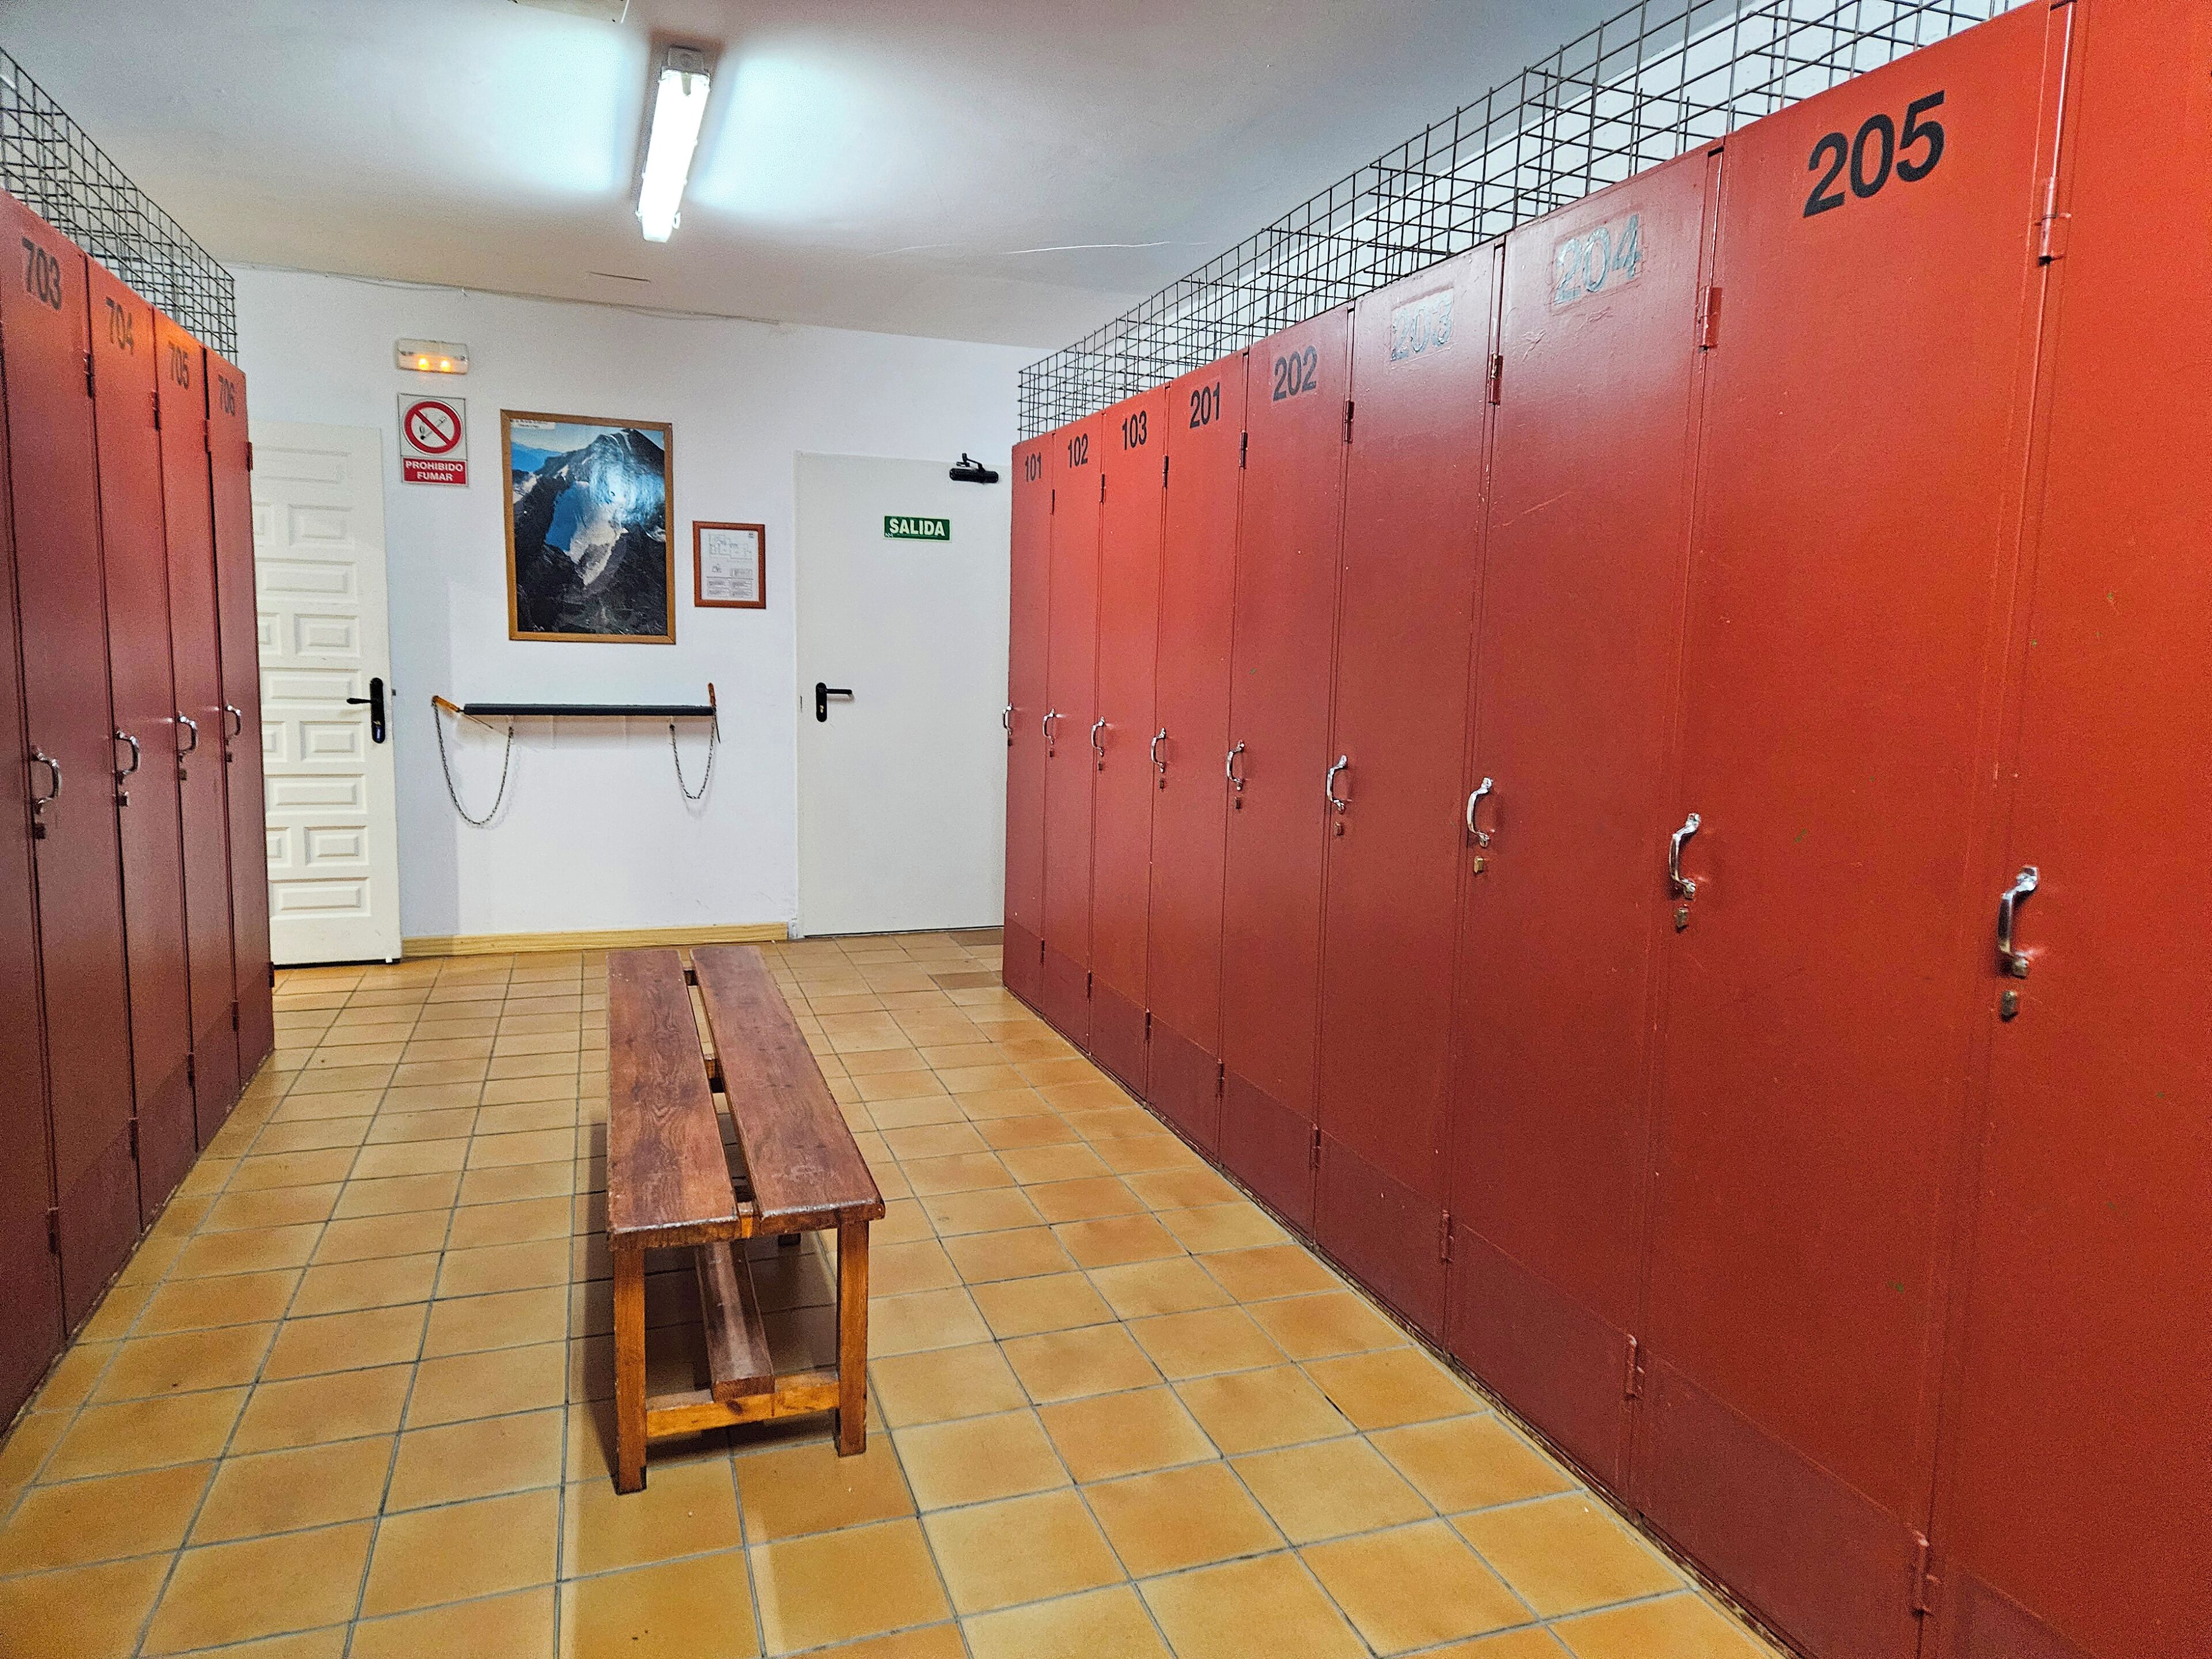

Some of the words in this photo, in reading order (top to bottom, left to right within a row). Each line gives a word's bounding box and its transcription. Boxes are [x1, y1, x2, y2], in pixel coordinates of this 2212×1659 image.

[1802, 89, 1946, 218] 205
[21, 237, 62, 310] 703
[1555, 212, 1642, 304] 204
[106, 296, 134, 355] 704
[1390, 289, 1453, 362] 203
[169, 340, 189, 390] 705
[1272, 346, 1317, 402] 202
[218, 374, 235, 416] 706
[1190, 382, 1220, 429] 201
[1067, 433, 1088, 468] 102
[1122, 410, 1147, 450] 103
[405, 460, 463, 472] PROHIBIDO
[416, 472, 453, 482] FUMAR
[1025, 452, 1041, 483] 101
[889, 518, 946, 536] SALIDA
